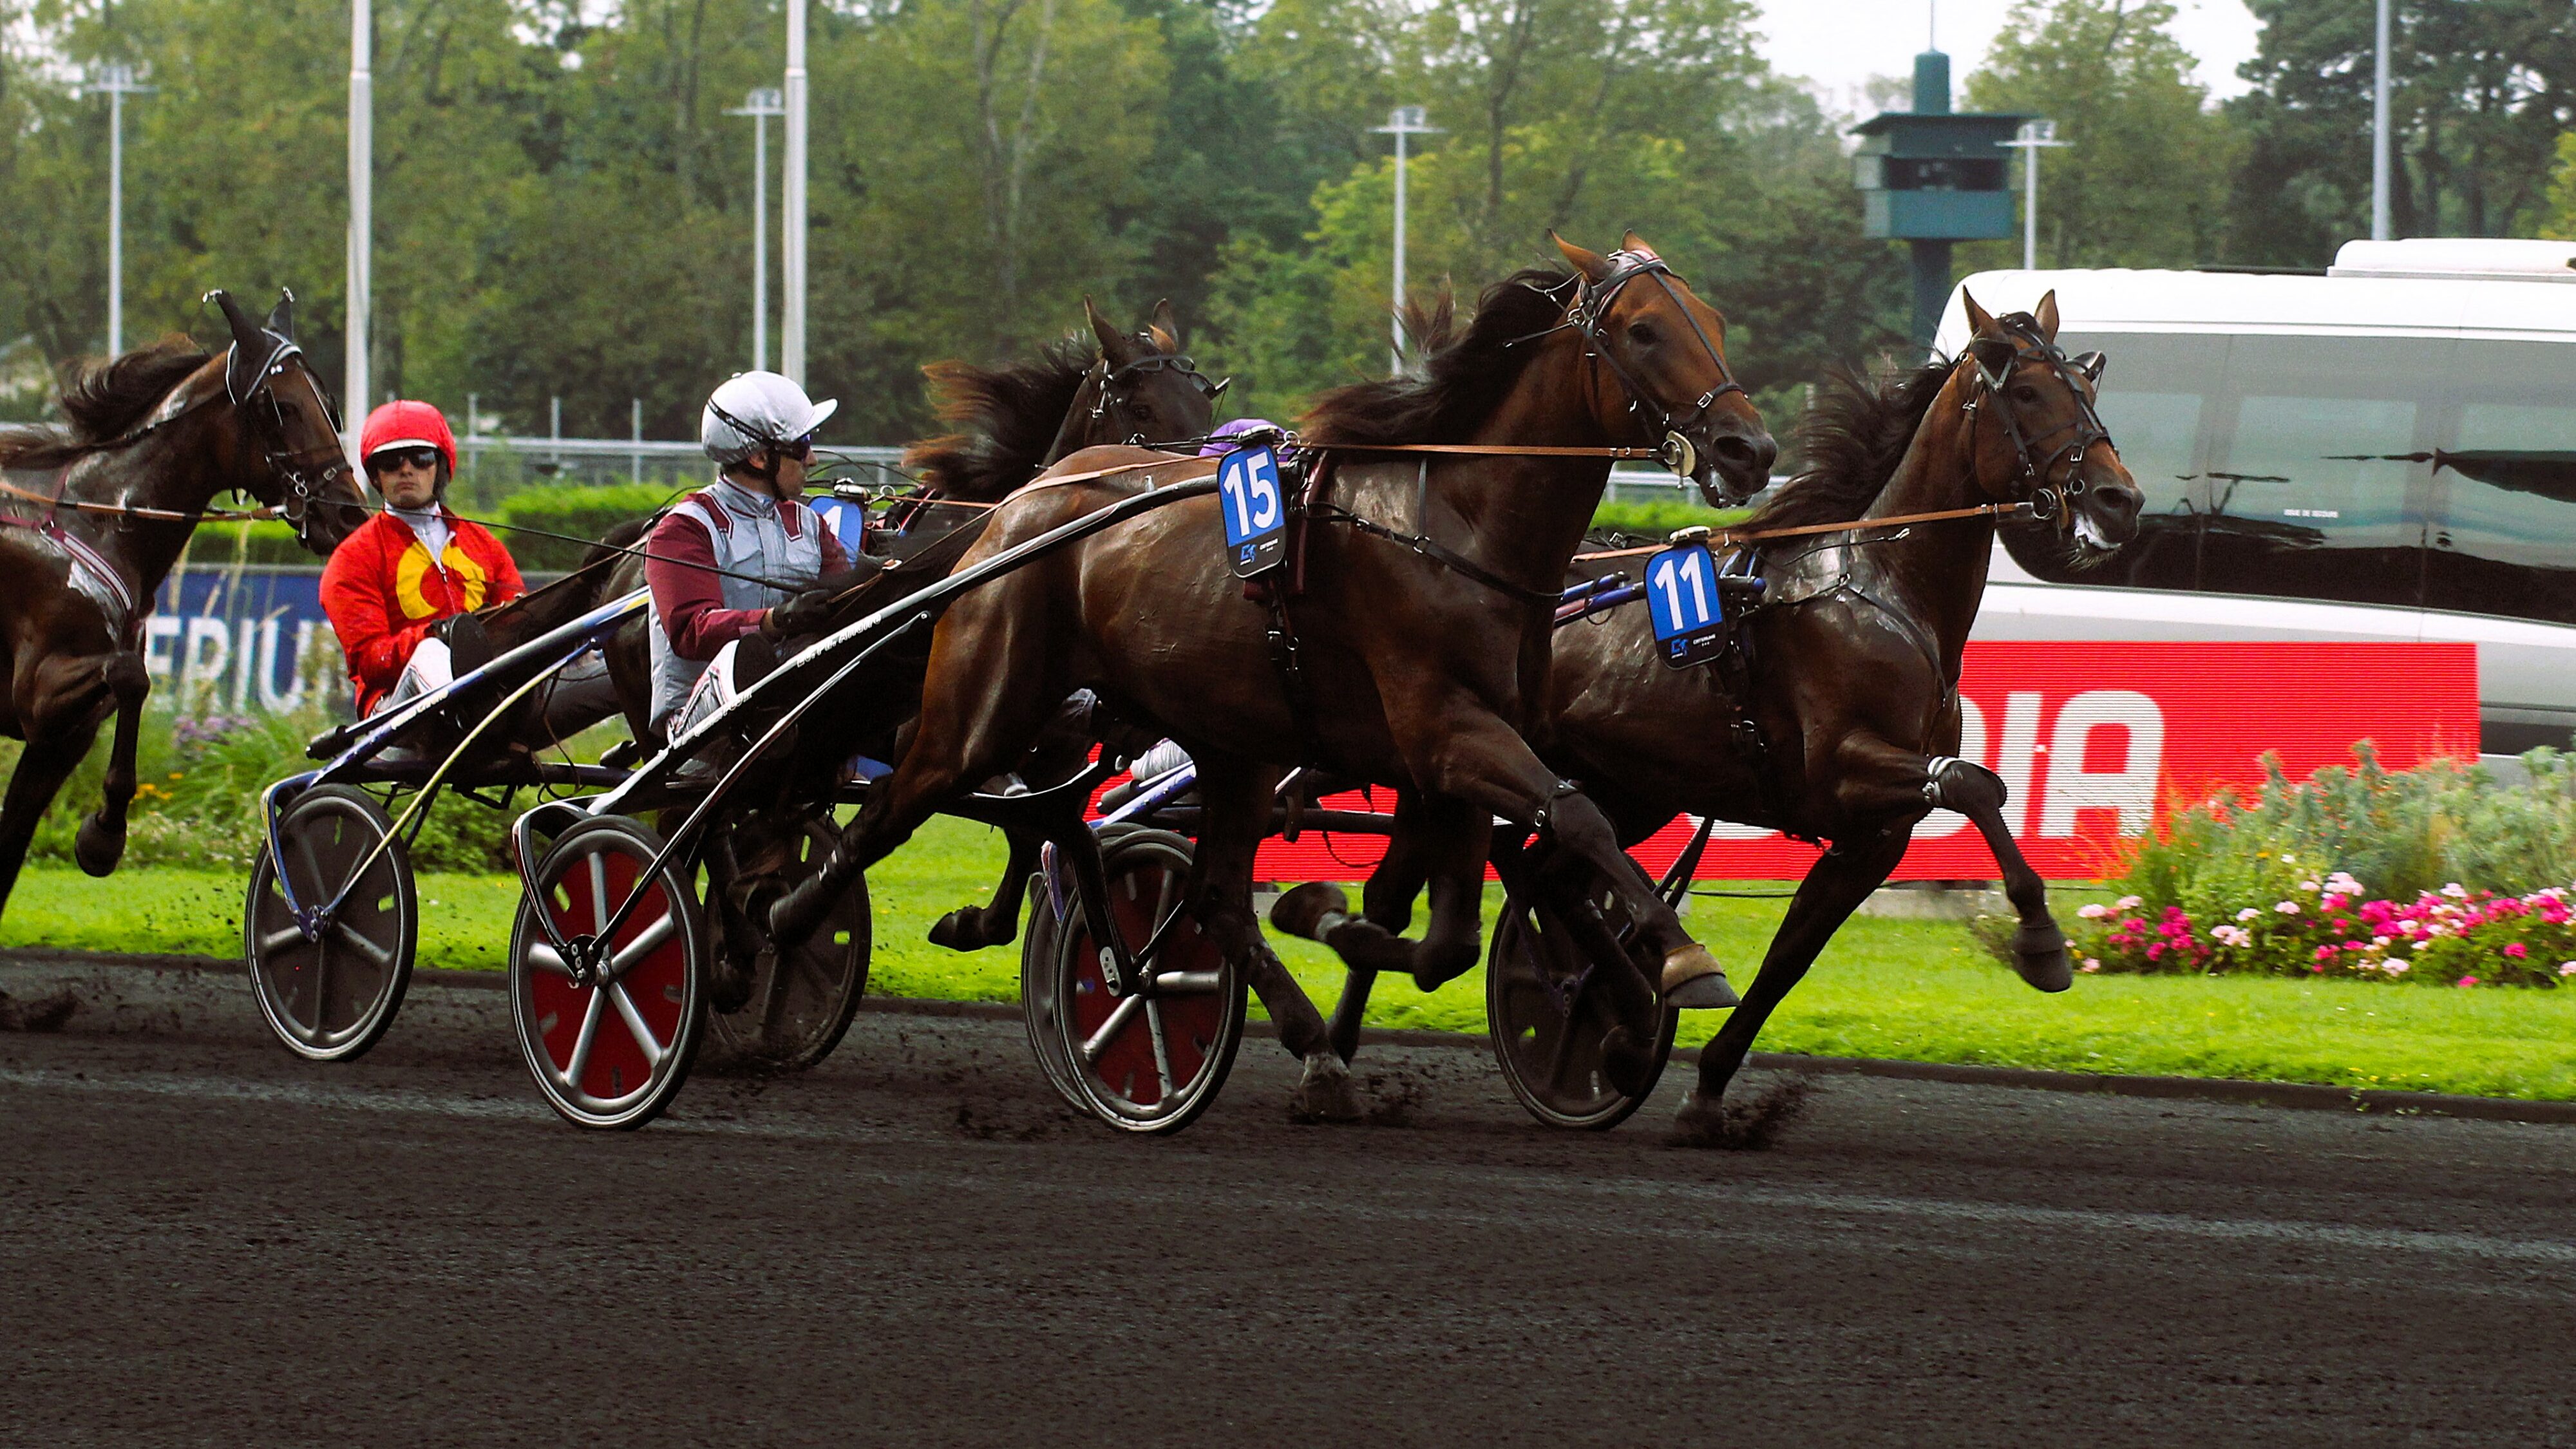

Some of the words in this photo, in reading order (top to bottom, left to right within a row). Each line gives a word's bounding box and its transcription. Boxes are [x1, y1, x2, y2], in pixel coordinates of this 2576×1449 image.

[1224, 451, 1276, 537] 15
[1654, 551, 1709, 631] 11
[145, 616, 355, 716] ERIU
